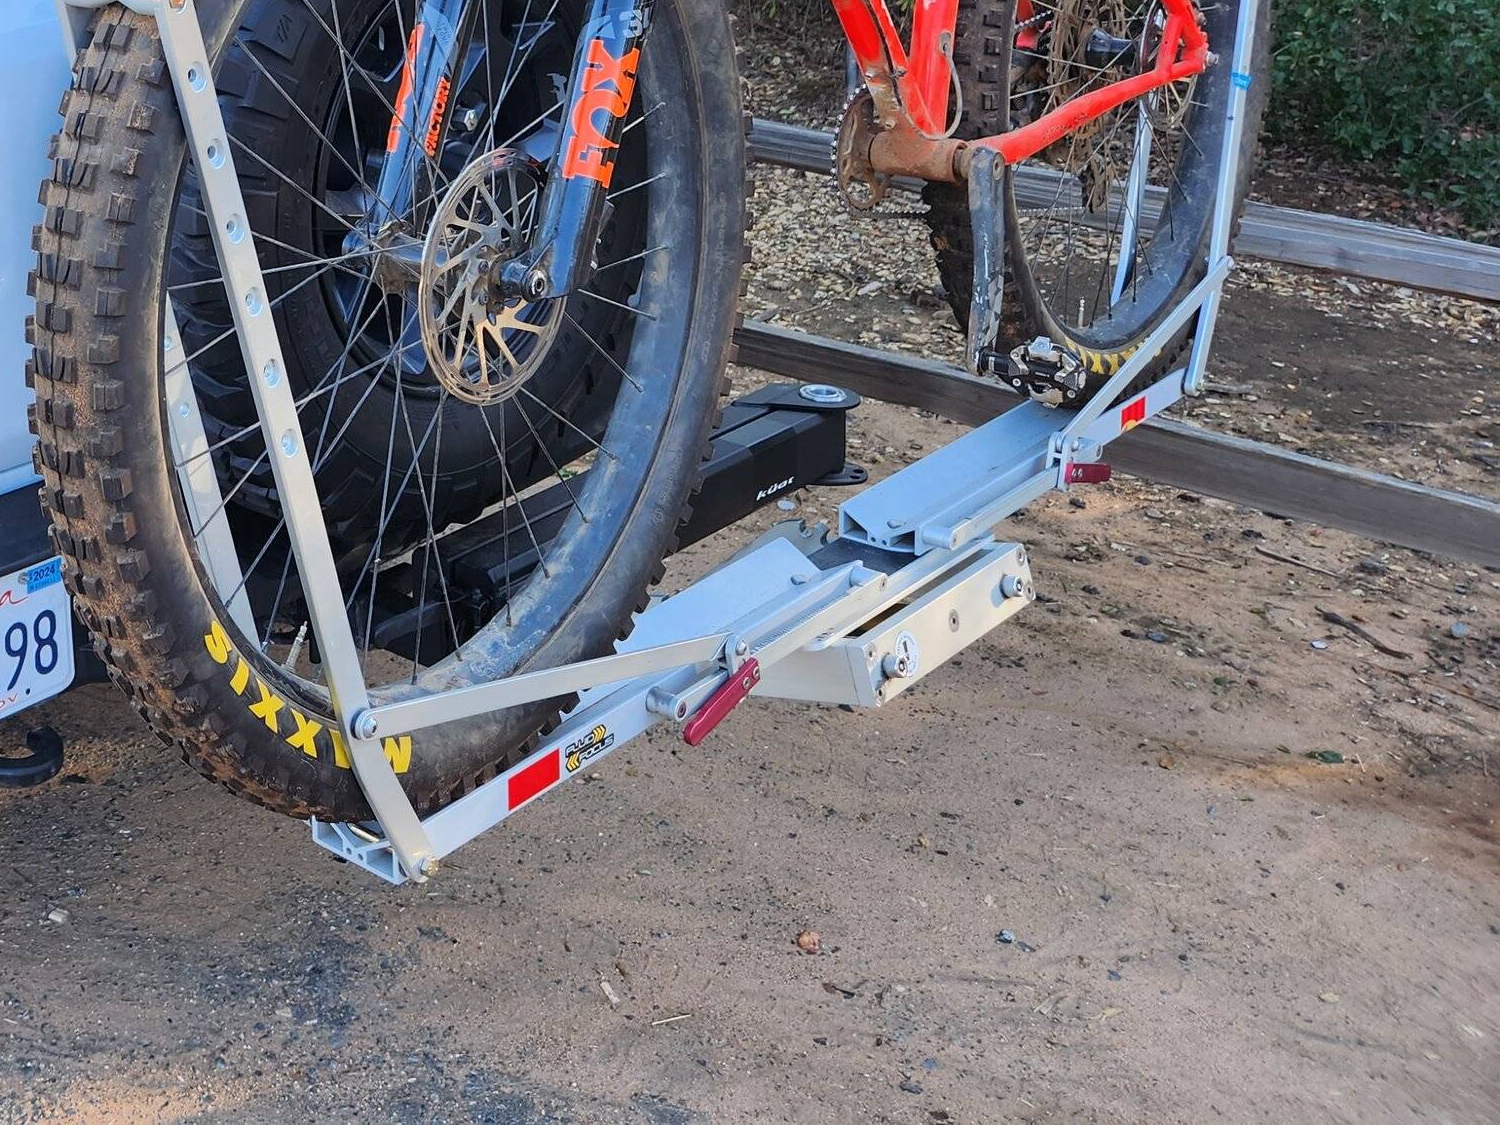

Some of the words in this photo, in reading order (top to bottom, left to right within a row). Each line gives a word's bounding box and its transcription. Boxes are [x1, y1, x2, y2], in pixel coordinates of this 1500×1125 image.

[424, 74, 452, 157] FACTORY
[561, 37, 641, 189] FOX
[33, 564, 56, 582] 2024
[578, 735, 614, 762] FOCUS
